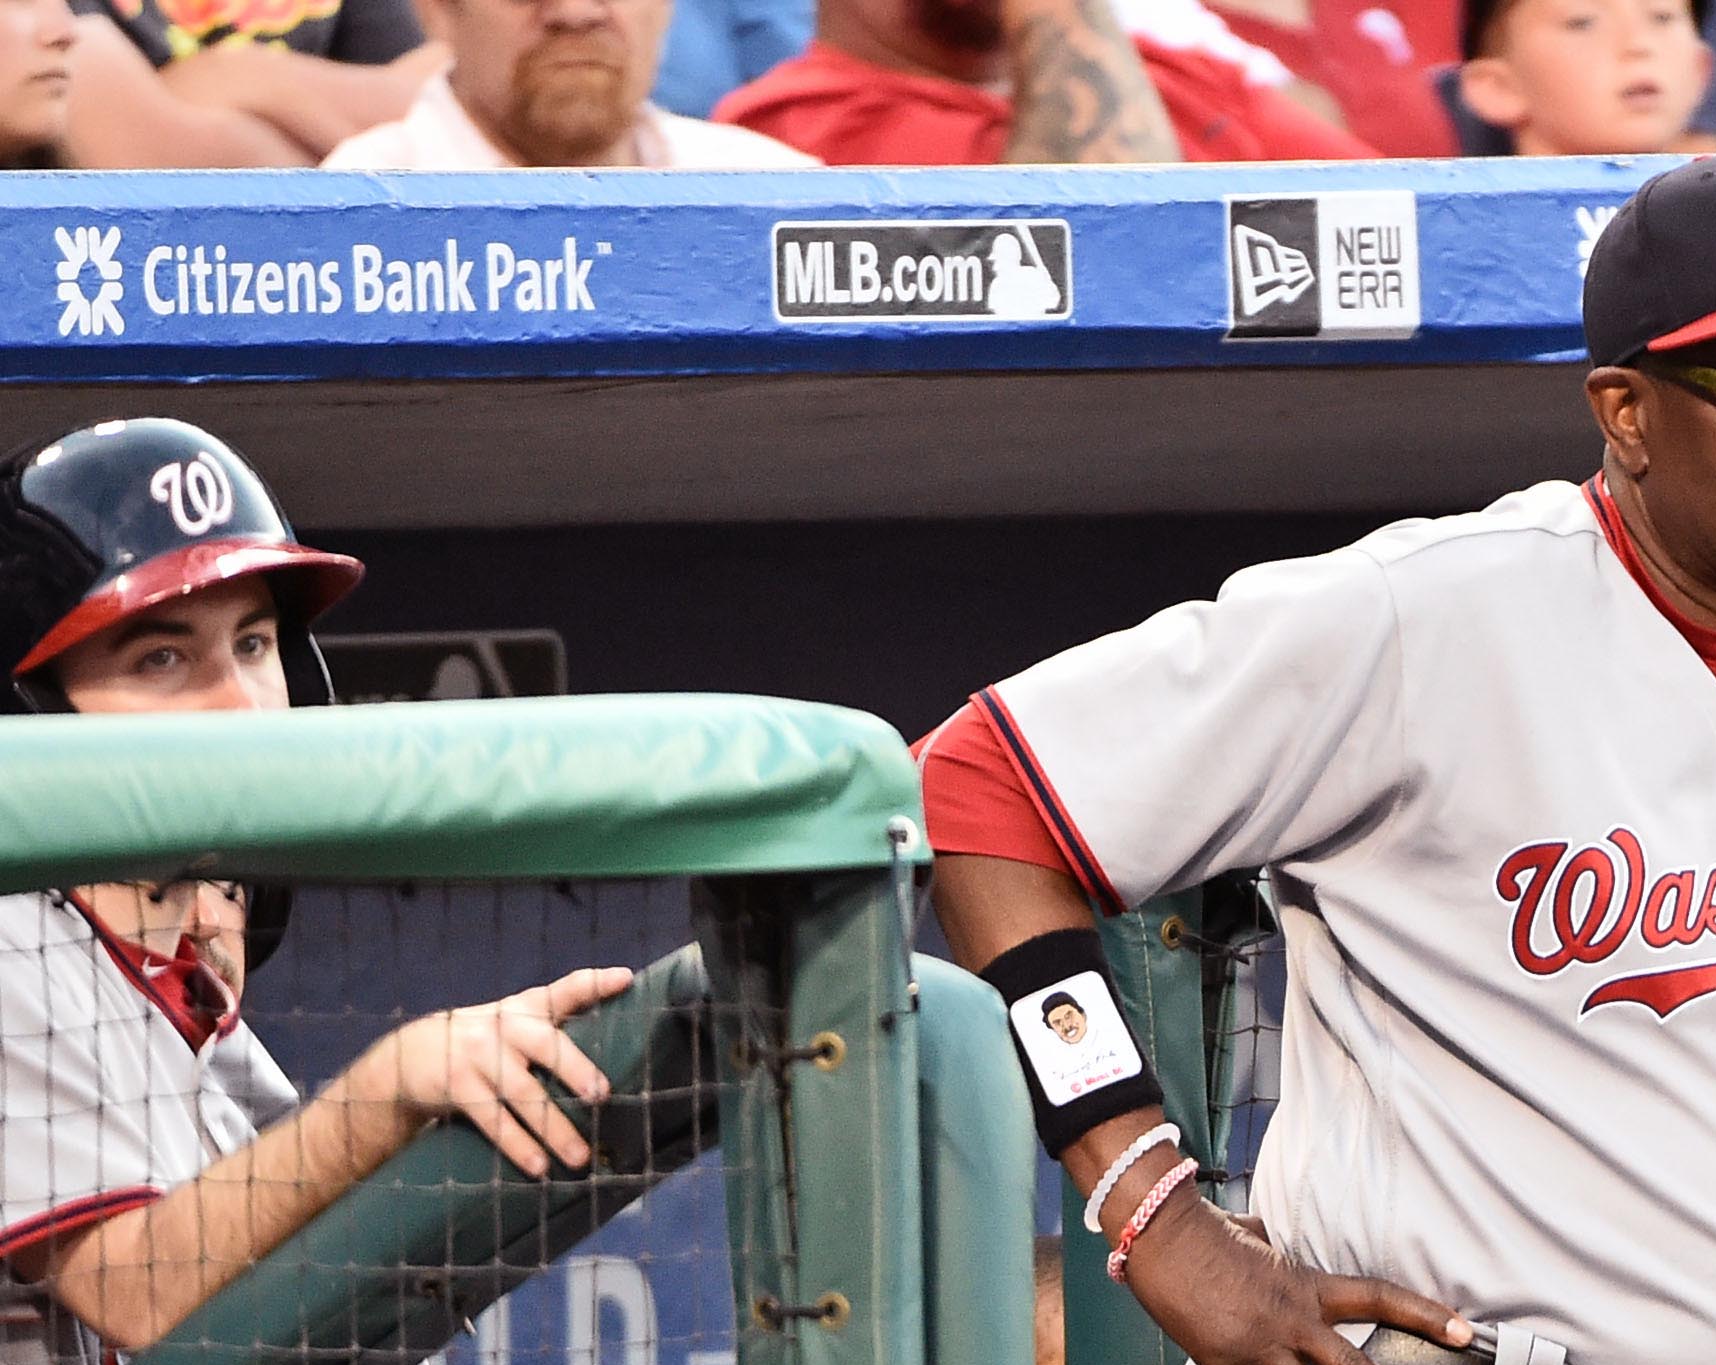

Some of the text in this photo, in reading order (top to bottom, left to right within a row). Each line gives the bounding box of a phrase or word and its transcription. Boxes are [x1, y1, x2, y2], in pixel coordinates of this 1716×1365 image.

[782, 238, 984, 306] MLB.com
[1334, 225, 1402, 266] NEW
[143, 243, 342, 316] Citizens
[352, 238, 477, 313] Bank
[1336, 270, 1405, 311] ERA
